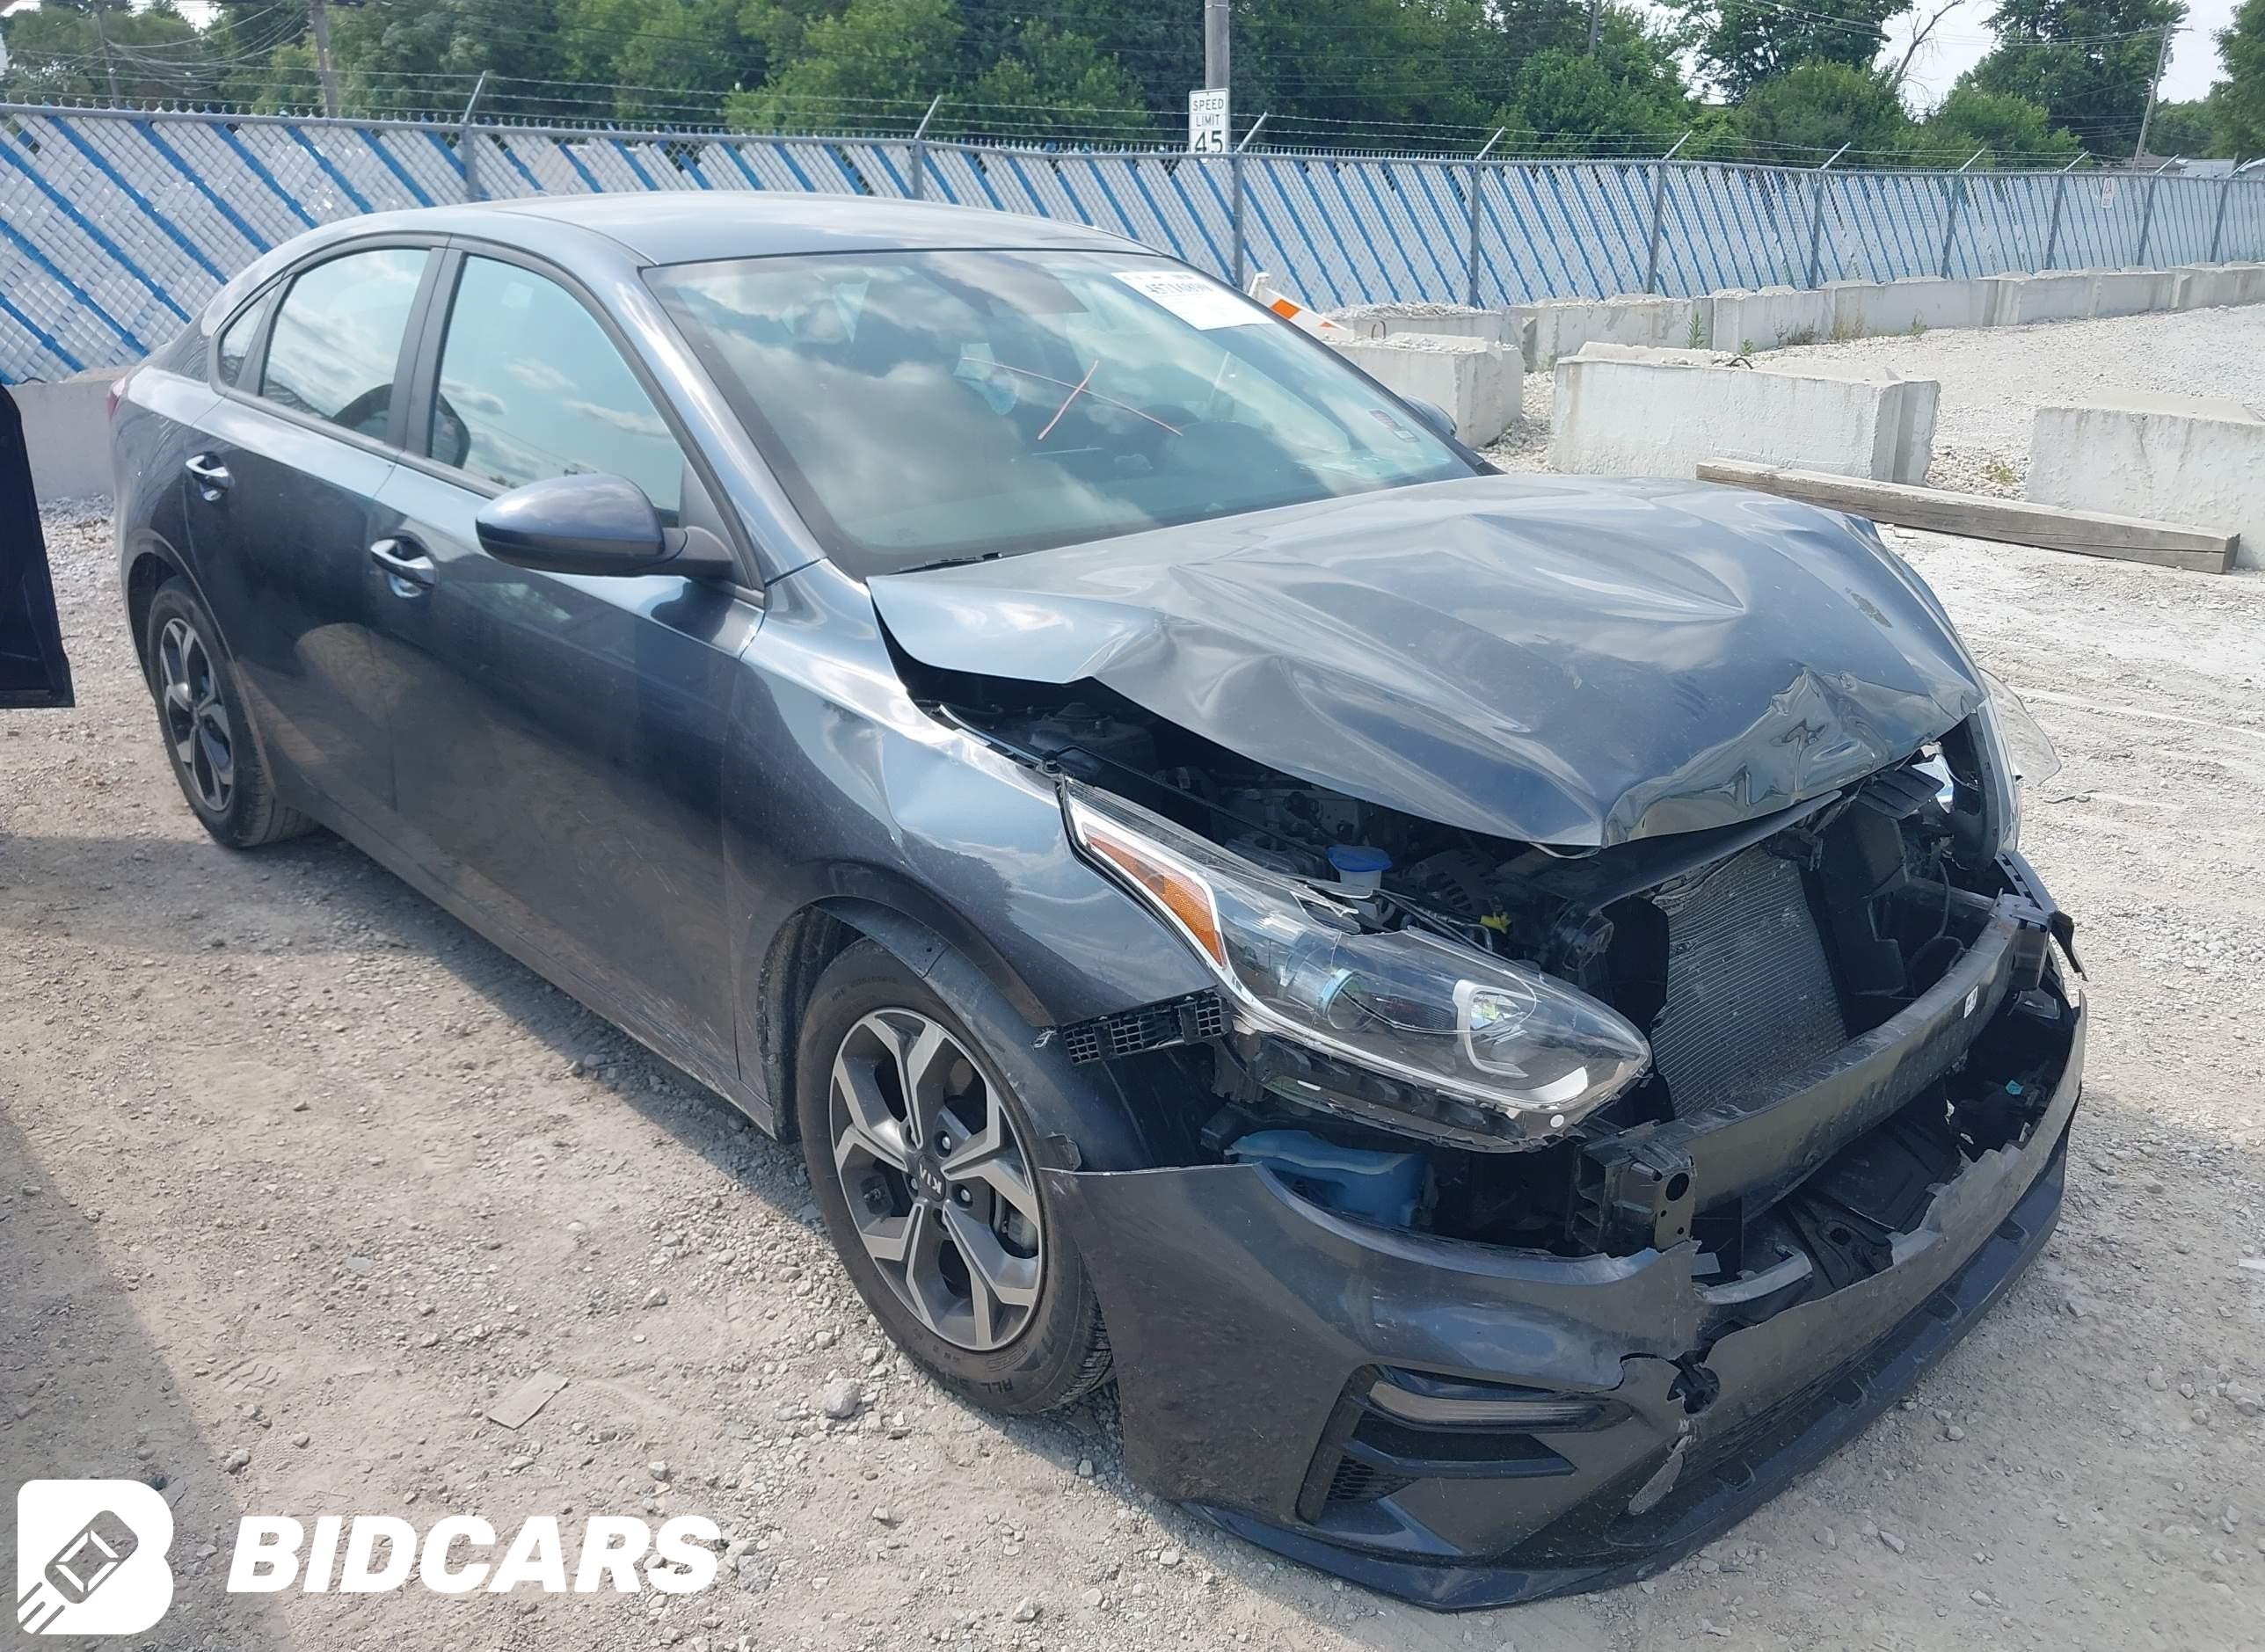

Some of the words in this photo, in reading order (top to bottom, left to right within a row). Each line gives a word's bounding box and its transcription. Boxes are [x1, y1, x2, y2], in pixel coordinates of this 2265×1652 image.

[1192, 98, 1224, 112] SPEED
[1196, 114, 1220, 127] LIMIT
[1194, 130, 1223, 153] 45
[919, 1162, 942, 1196] KIA
